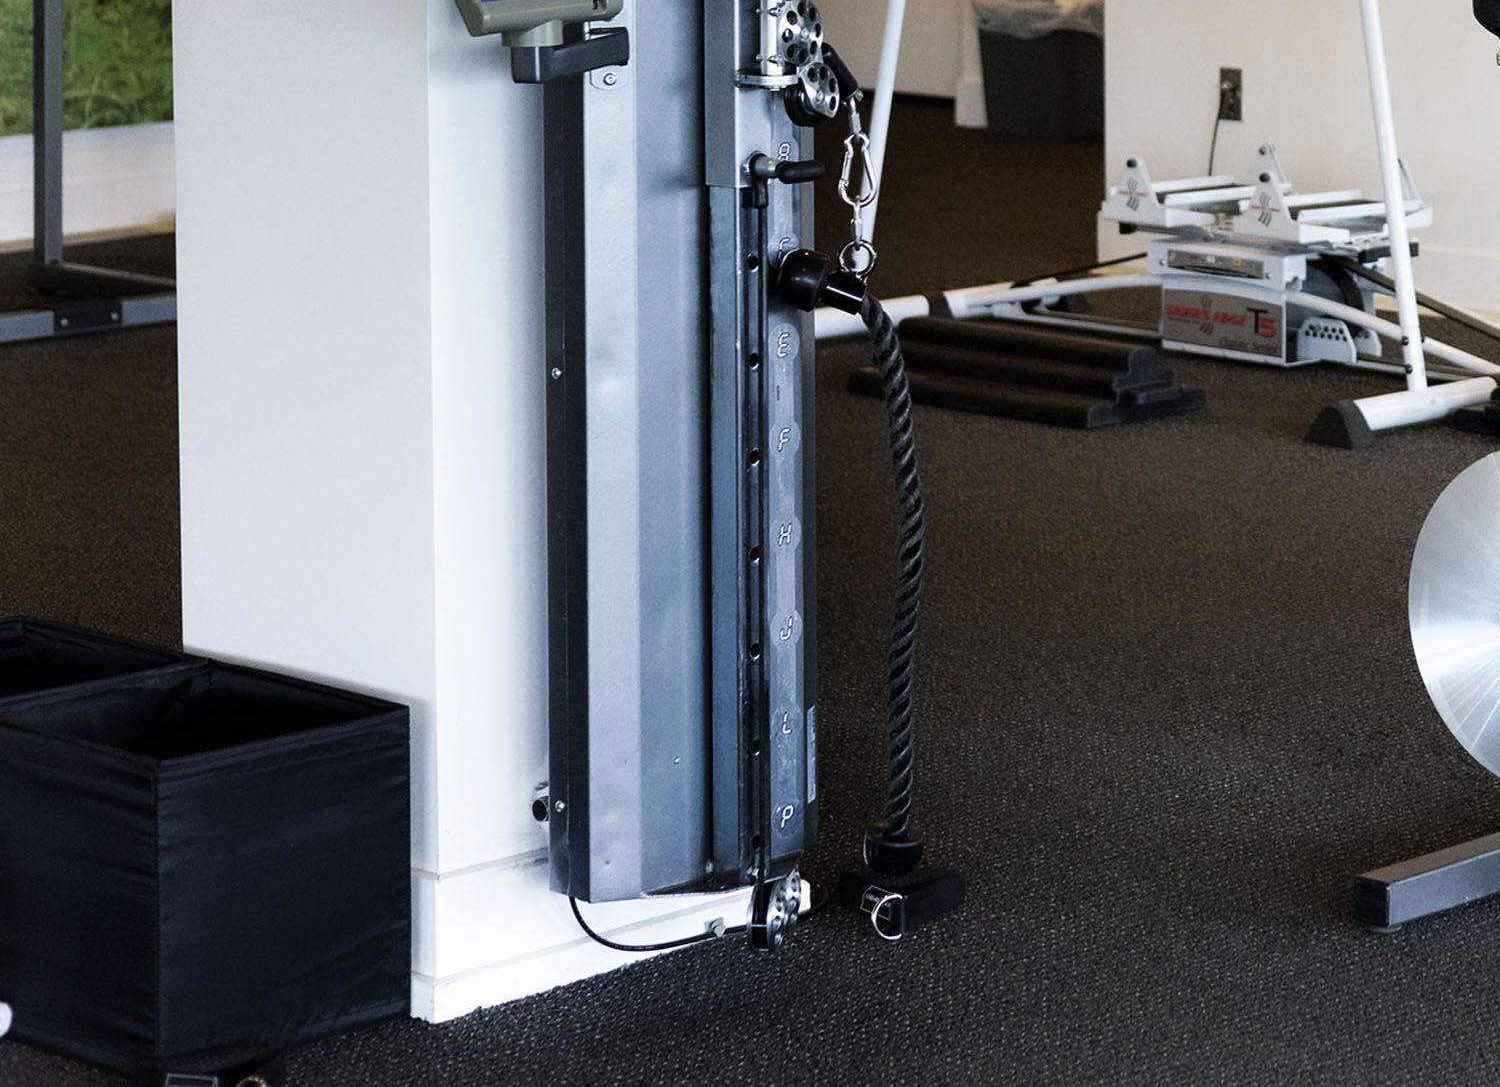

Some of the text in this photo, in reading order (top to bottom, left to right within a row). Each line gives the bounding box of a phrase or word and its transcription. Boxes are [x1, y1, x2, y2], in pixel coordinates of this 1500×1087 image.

[776, 332, 790, 359] E
[777, 427, 791, 453] F
[777, 522, 793, 546] H
[779, 615, 794, 641] J
[781, 711, 792, 735] L
[780, 803, 795, 829] P
